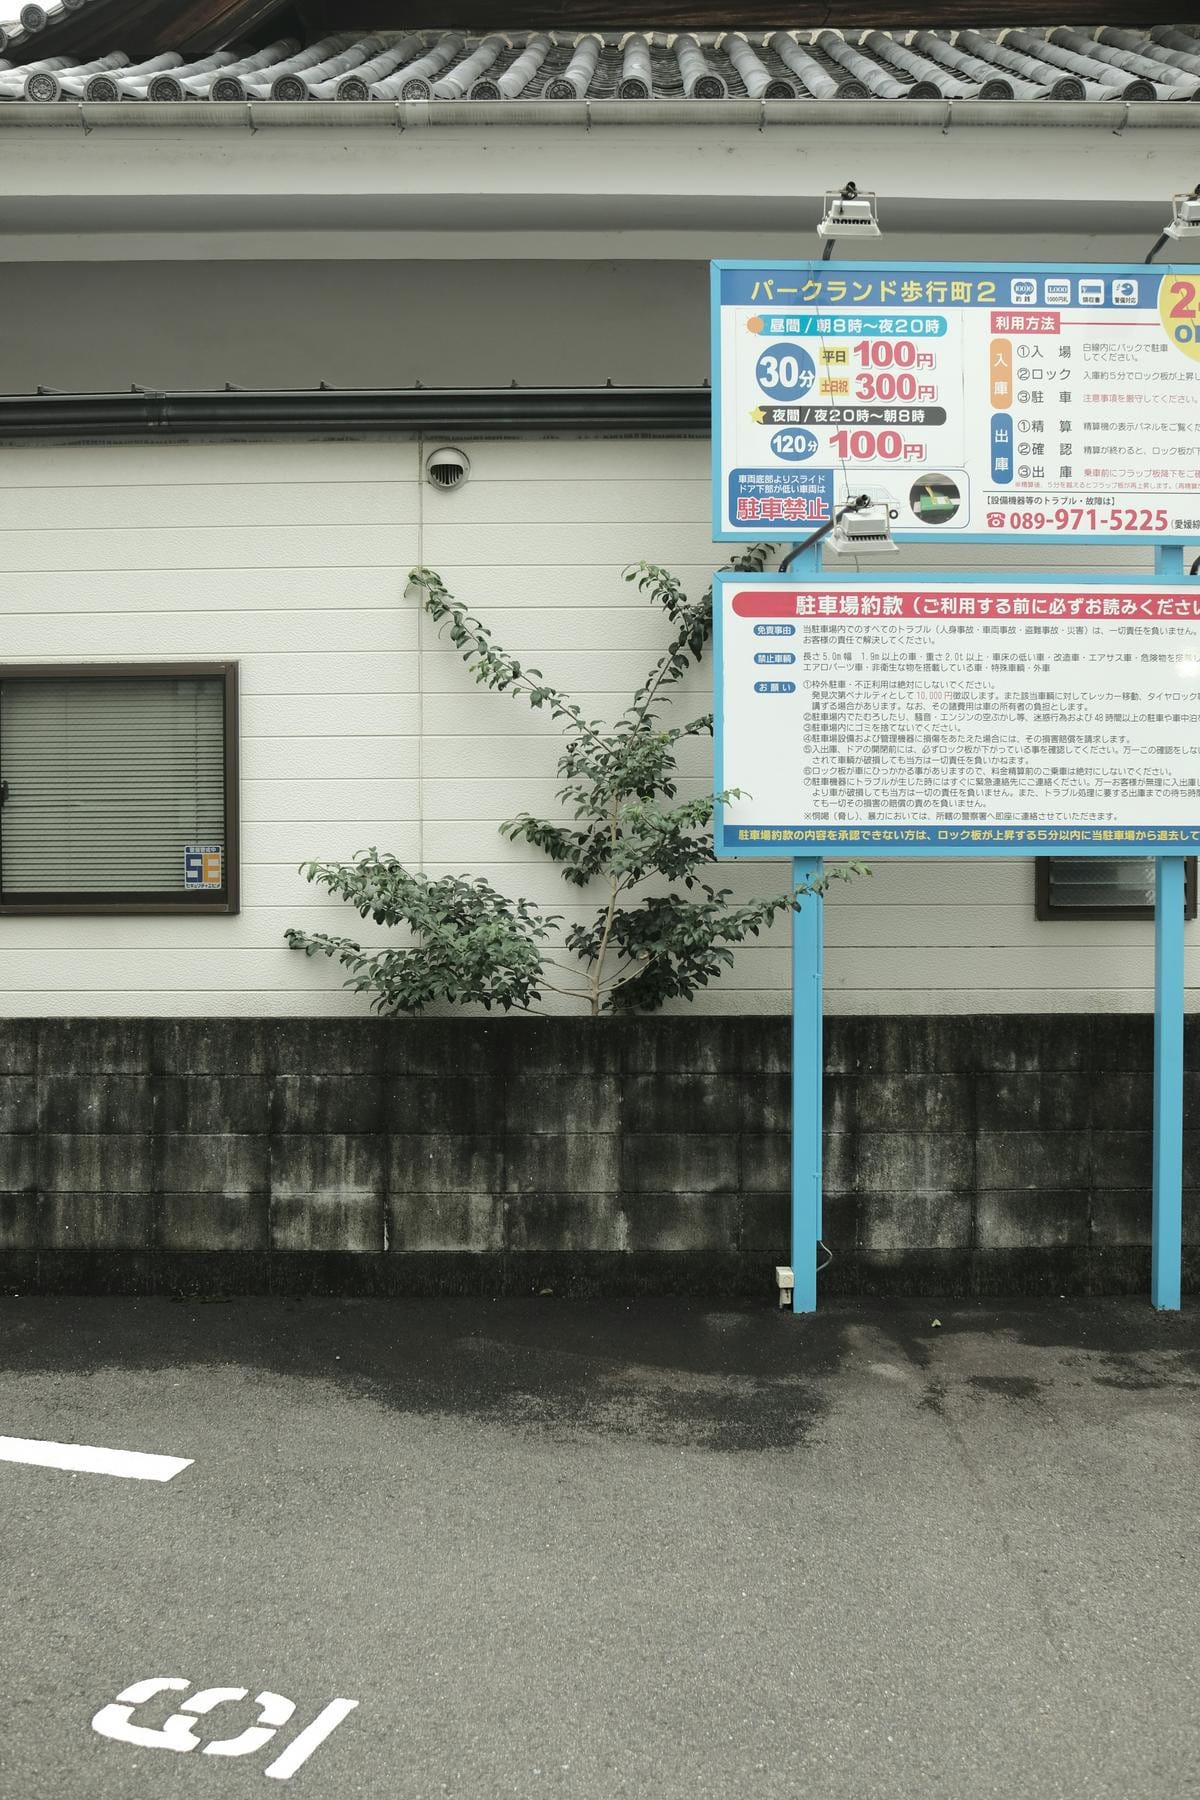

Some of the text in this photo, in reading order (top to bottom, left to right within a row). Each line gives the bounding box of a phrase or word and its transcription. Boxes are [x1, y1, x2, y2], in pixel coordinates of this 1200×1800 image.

[751, 279, 996, 303] パークランド歩行町2
[1170, 281, 1200, 318] 2
[995, 316, 1055, 331] 利用方法
[822, 351, 846, 363] 平日
[853, 340, 935, 368] 100円
[1083, 352, 1139, 362] してください。
[759, 356, 815, 389] 30分
[993, 353, 1009, 396] 入庫
[821, 380, 848, 394] 土日祝
[855, 372, 935, 400] 300円
[772, 435, 818, 453] 120分
[829, 430, 924, 459] 100円
[994, 428, 1009, 471] 出庫
[738, 474, 825, 484] 車両底部よりスライド
[739, 484, 826, 494] ドア下部が低い車両は
[737, 497, 830, 521] 駐車禁止
[1010, 508, 1168, 531] 089-971-5225
[757, 626, 792, 635] 免責事由
[803, 635, 935, 645] お客様の責任で解決してください。
